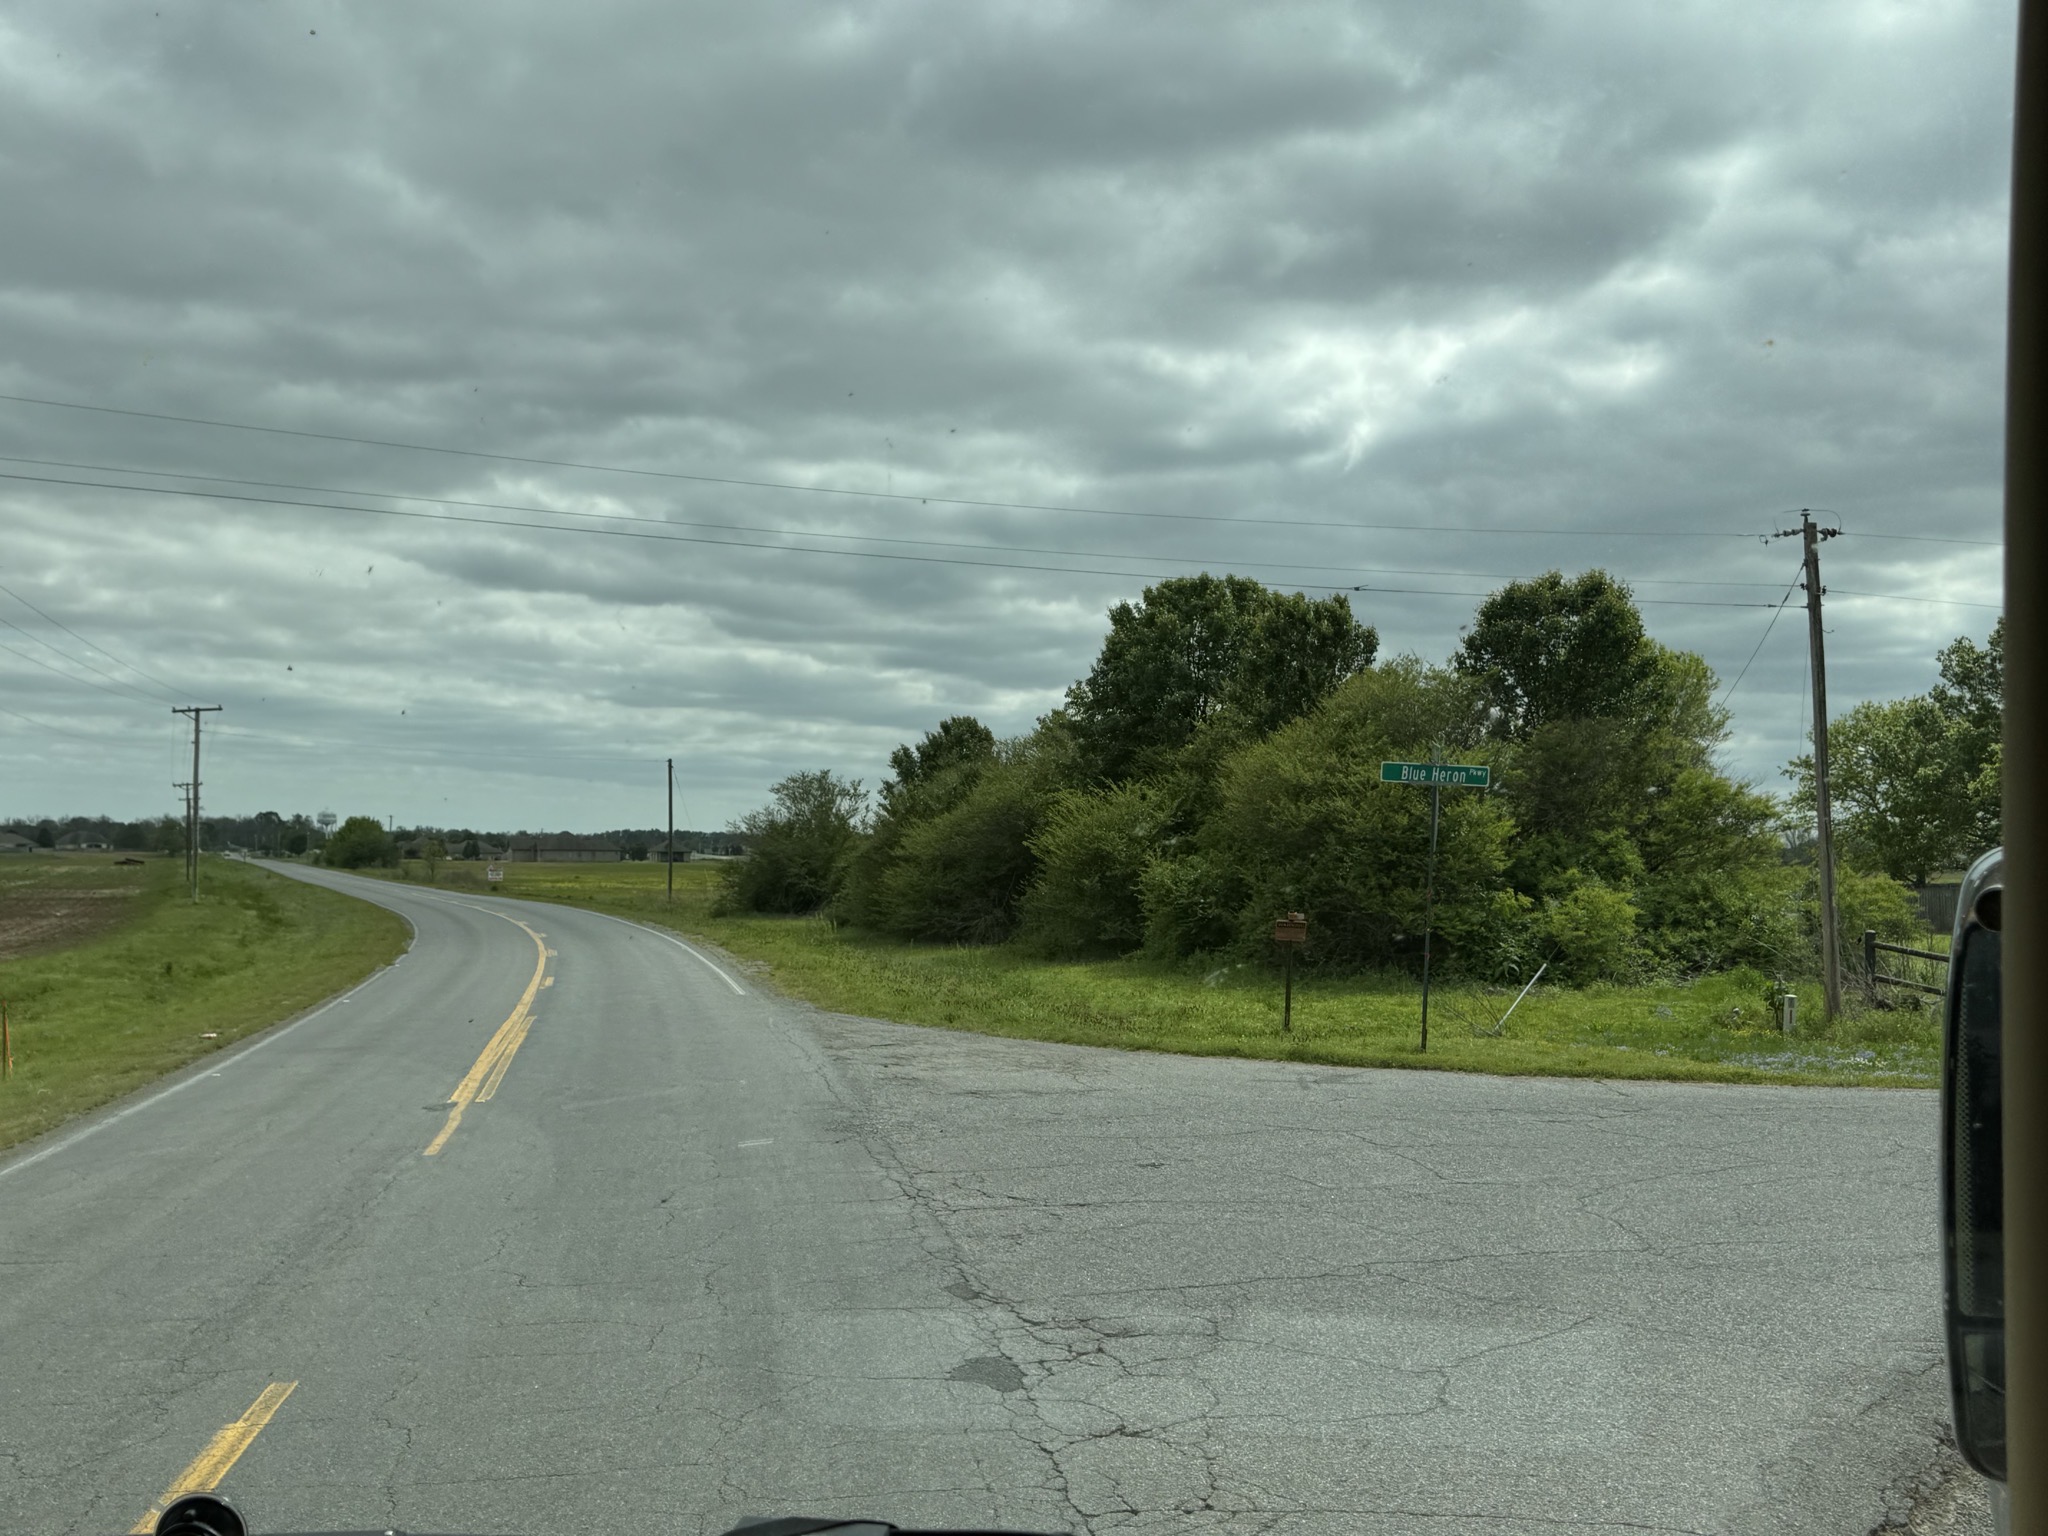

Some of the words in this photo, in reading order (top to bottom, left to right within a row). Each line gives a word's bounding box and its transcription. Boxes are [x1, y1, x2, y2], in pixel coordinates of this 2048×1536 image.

[1401, 765, 1426, 780] Blue
[1432, 767, 1466, 783] Heron
[1469, 768, 1486, 777] Pkwy
